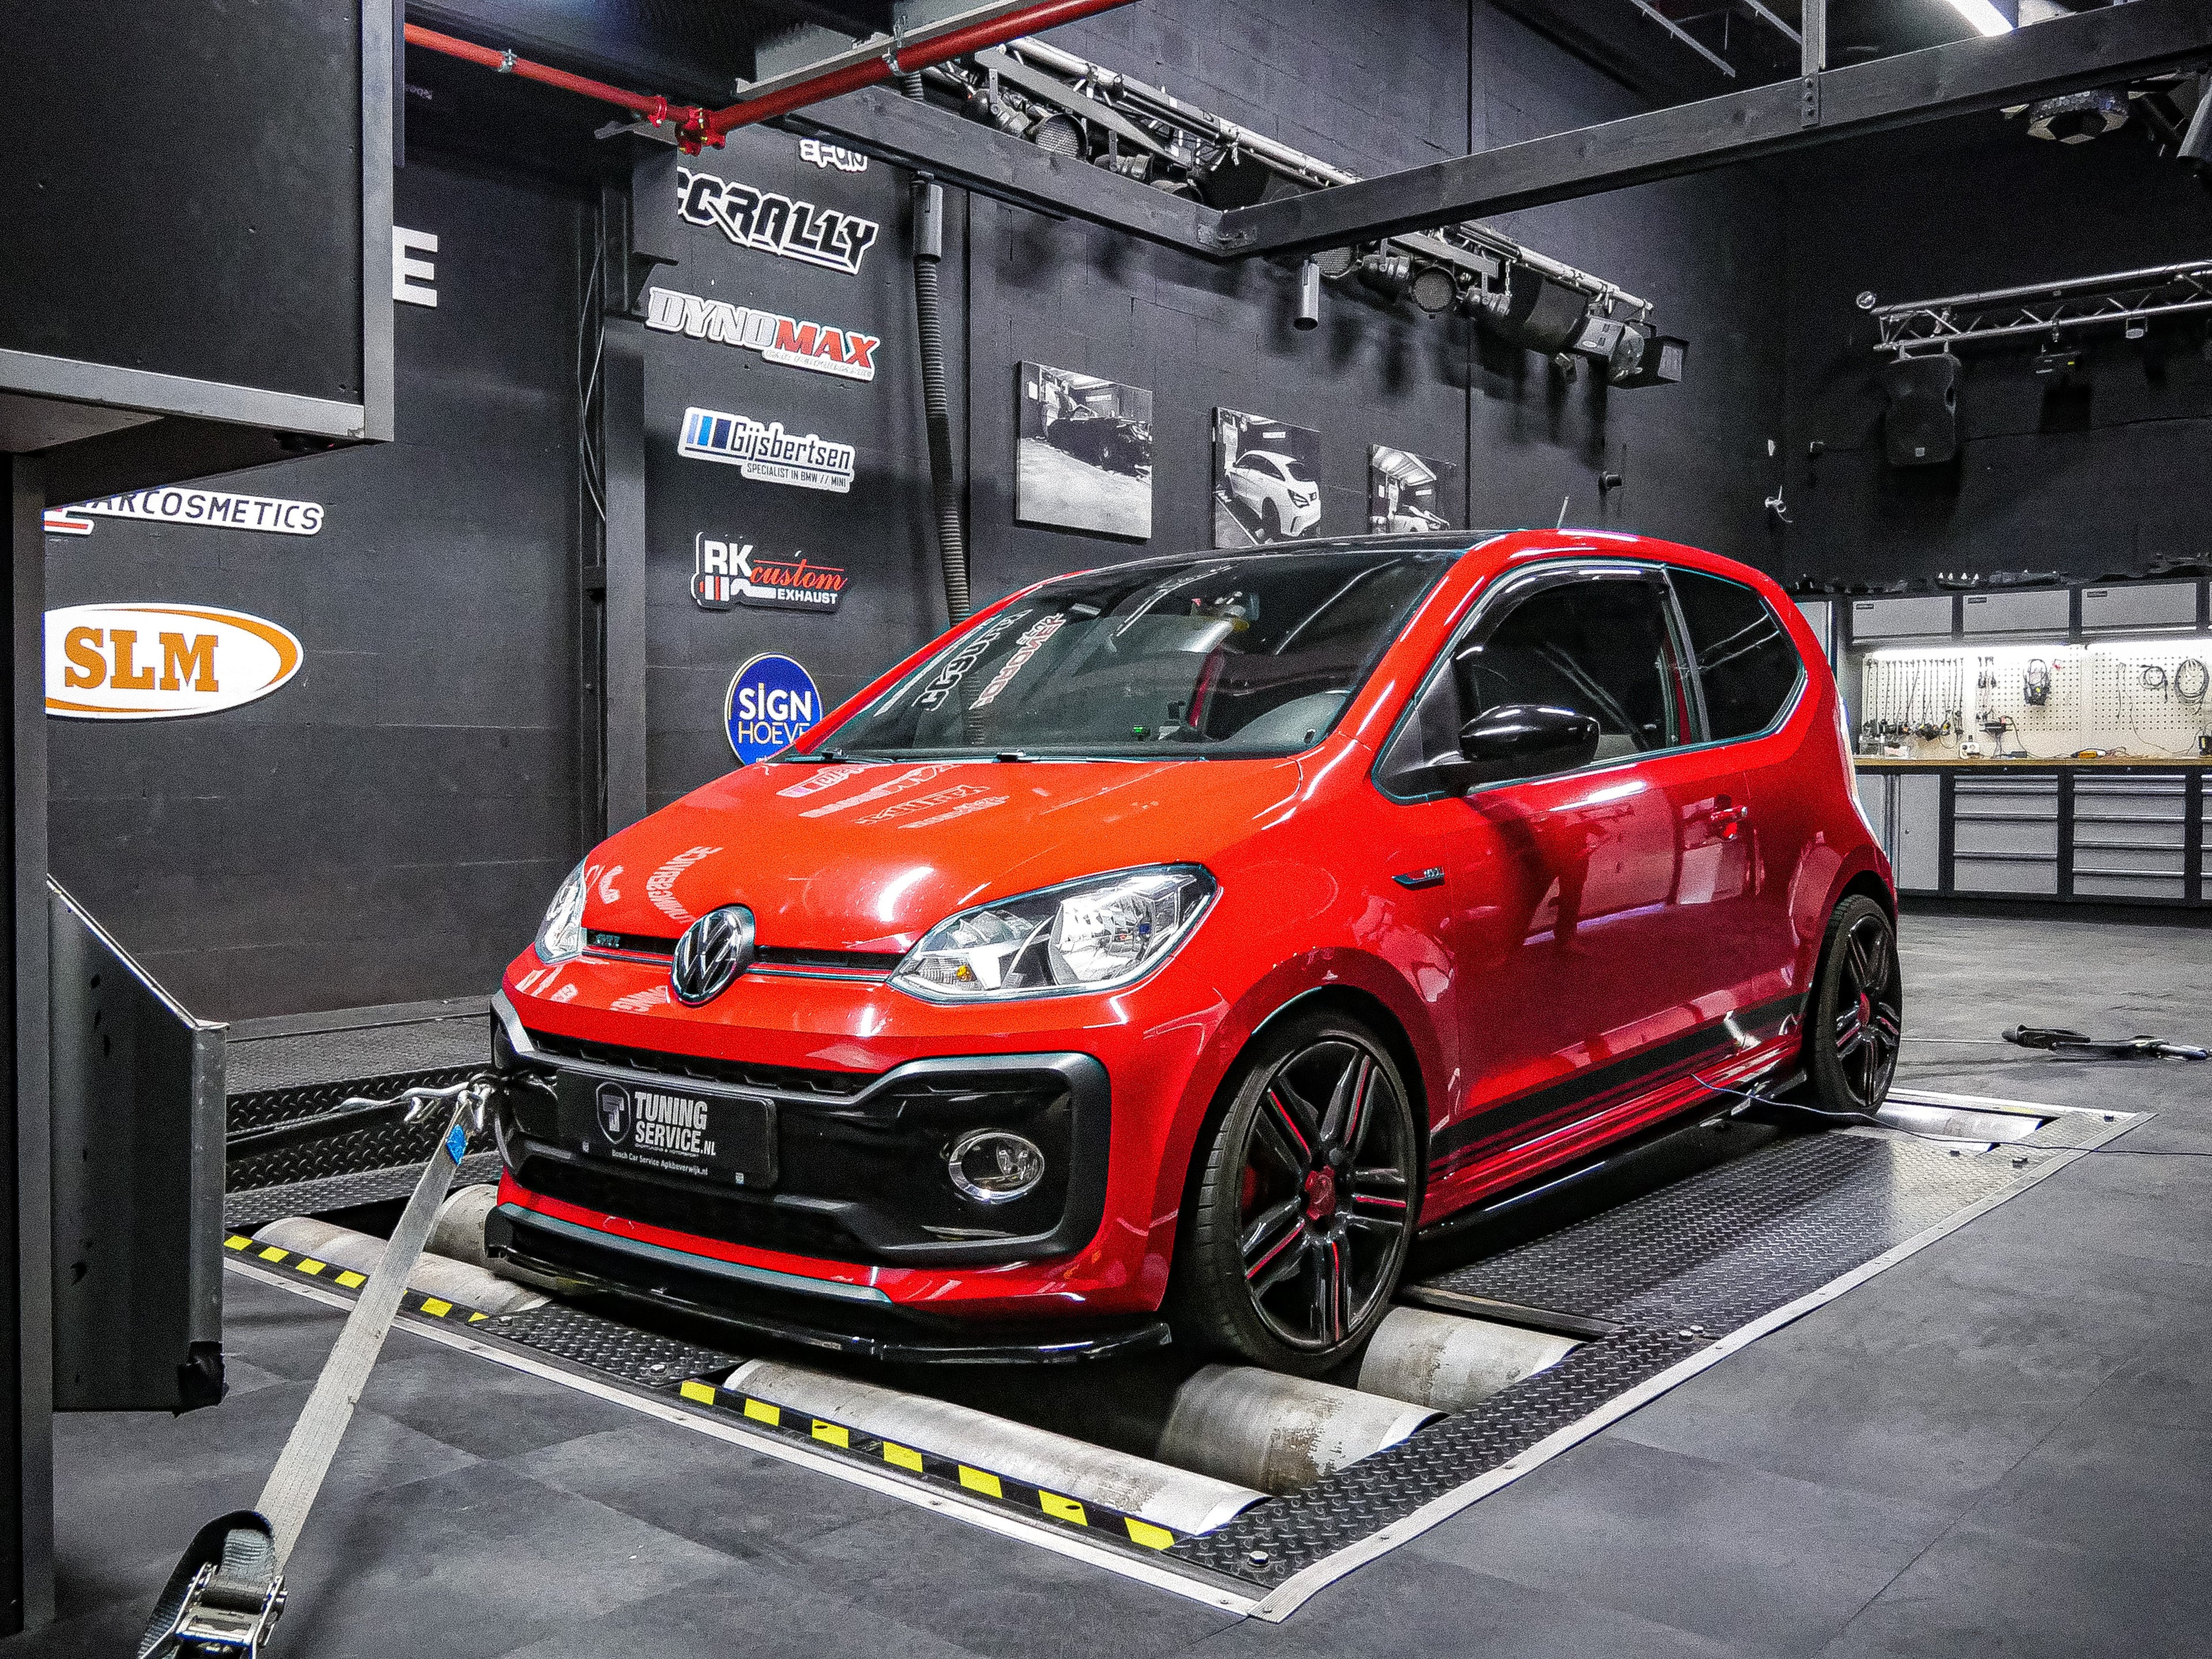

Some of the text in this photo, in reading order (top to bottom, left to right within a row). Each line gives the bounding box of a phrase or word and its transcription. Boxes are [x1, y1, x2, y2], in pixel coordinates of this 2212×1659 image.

[649, 290, 877, 369] DYNOMAX
[730, 421, 850, 469] Gijsbertsen
[747, 463, 789, 479] SPECIALIST
[791, 470, 798, 480] IN
[801, 471, 818, 483] BMW
[831, 476, 846, 487] MINI
[76, 490, 320, 529] RCOSMETICS
[704, 540, 753, 577] RK
[750, 558, 847, 592] custom
[778, 588, 838, 604] EXHAUST
[65, 626, 219, 692] SLM
[635, 1092, 708, 1130] TUNING
[628, 1153, 638, 1161] Car
[639, 1156, 660, 1166] Service
